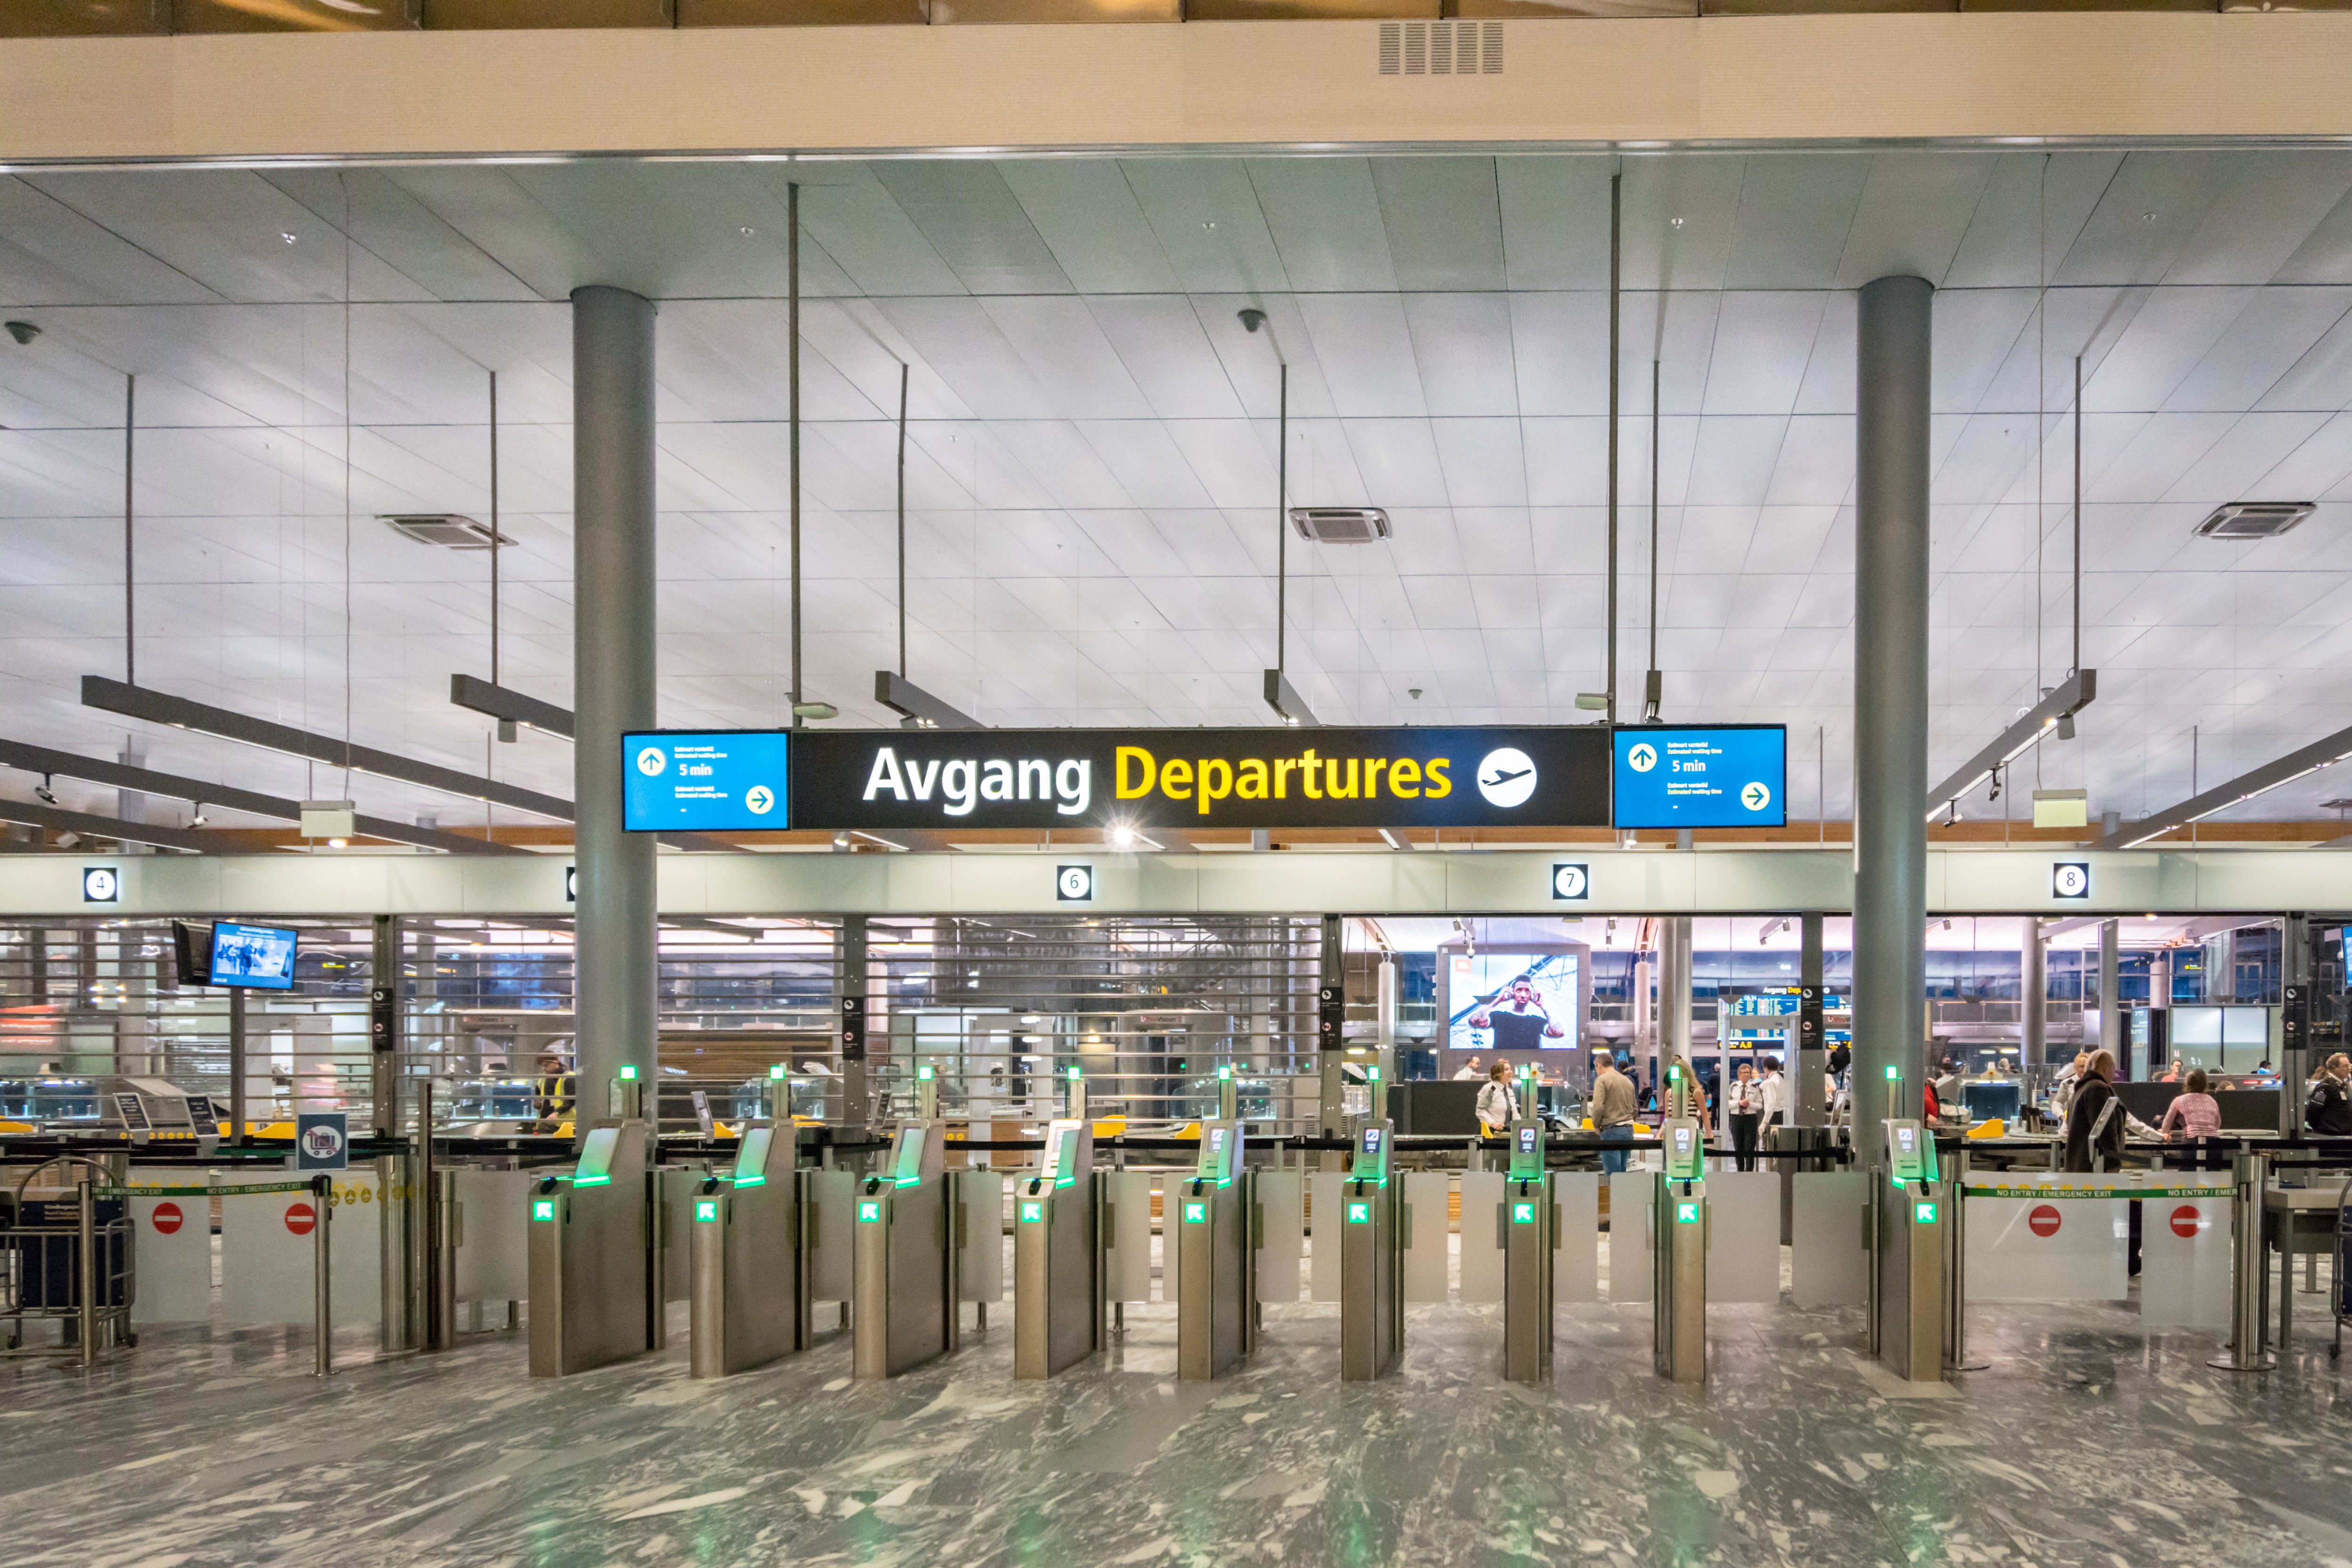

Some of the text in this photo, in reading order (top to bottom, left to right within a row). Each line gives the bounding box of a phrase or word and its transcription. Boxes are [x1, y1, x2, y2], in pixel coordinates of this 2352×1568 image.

[679, 764, 713, 776] 5 min
[1672, 759, 1706, 772] 5 min
[862, 746, 1453, 815] Avgang Departures
[97, 877, 104, 891] 4
[1070, 875, 1079, 889] 6
[1566, 874, 1575, 888] 7
[2066, 872, 2075, 886] 8
[245, 1183, 285, 1193] EMERGENCY
